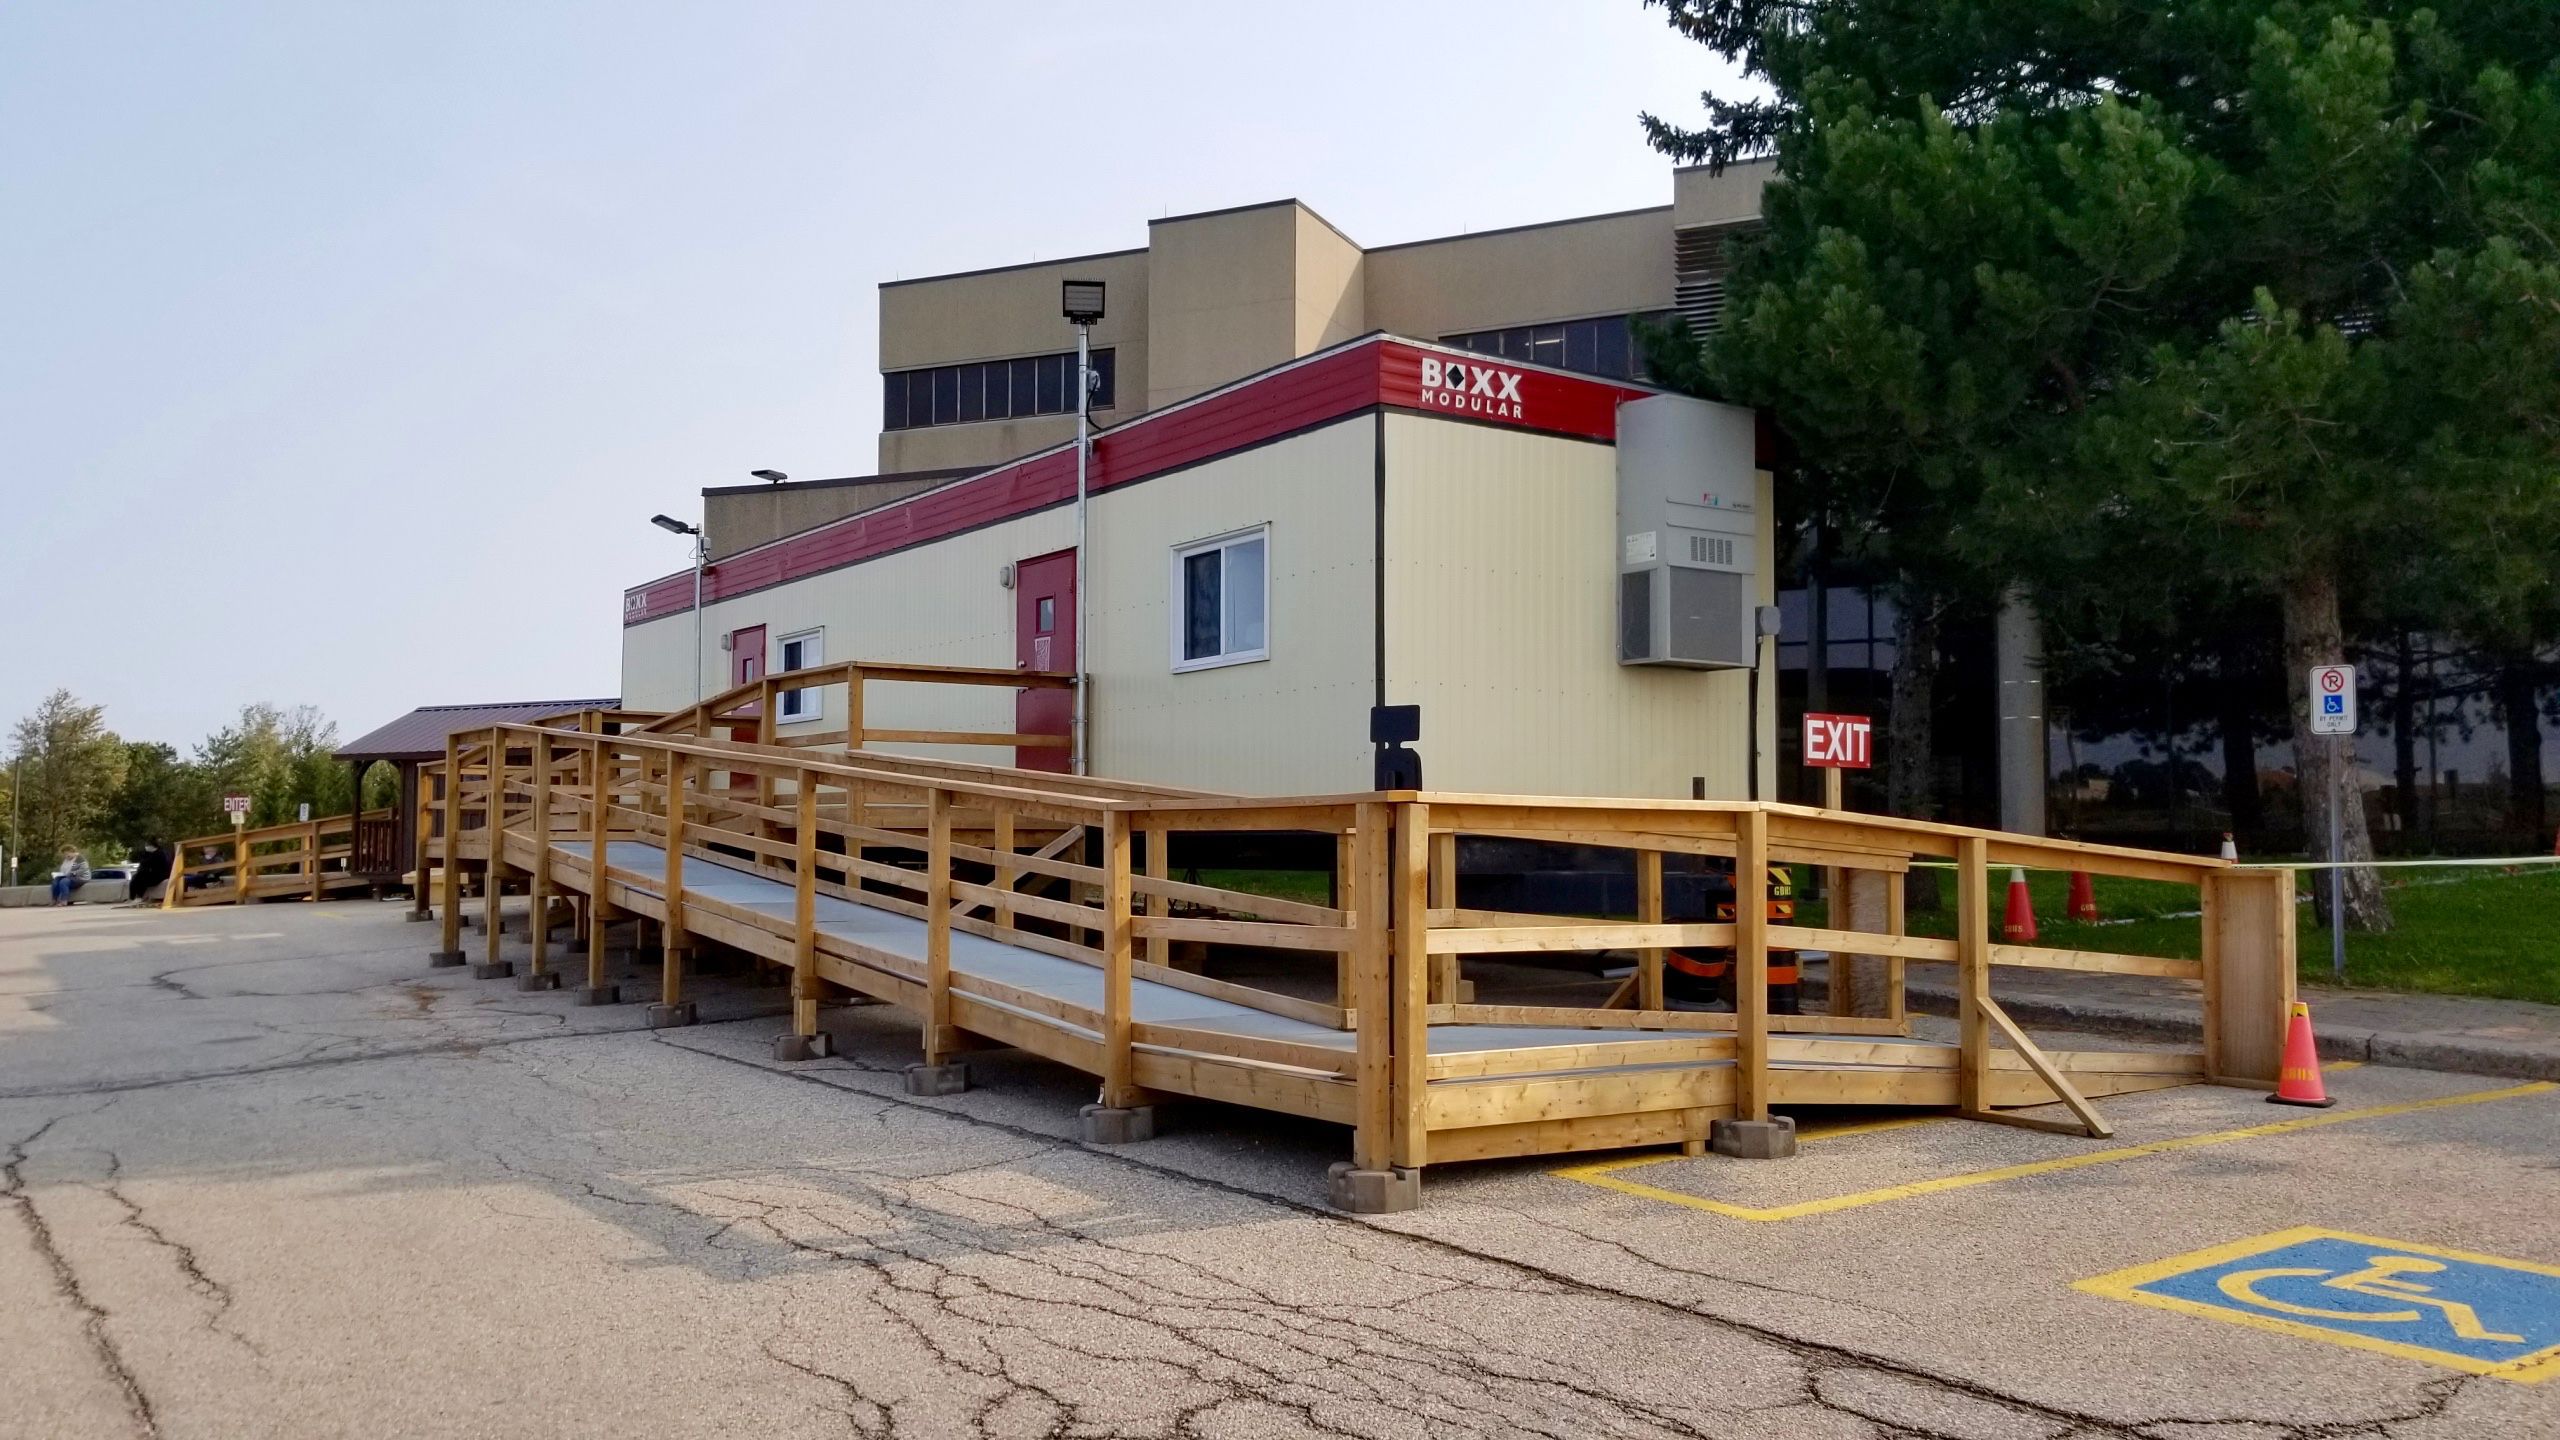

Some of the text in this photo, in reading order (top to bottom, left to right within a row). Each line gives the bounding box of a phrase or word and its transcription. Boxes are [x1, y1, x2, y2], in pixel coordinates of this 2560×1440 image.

[1422, 357, 1522, 403] BOXX
[1422, 389, 1522, 418] MODULAR
[625, 592, 647, 612] BOXX
[1807, 719, 1870, 762] EXIT
[224, 796, 251, 812] ENTER
